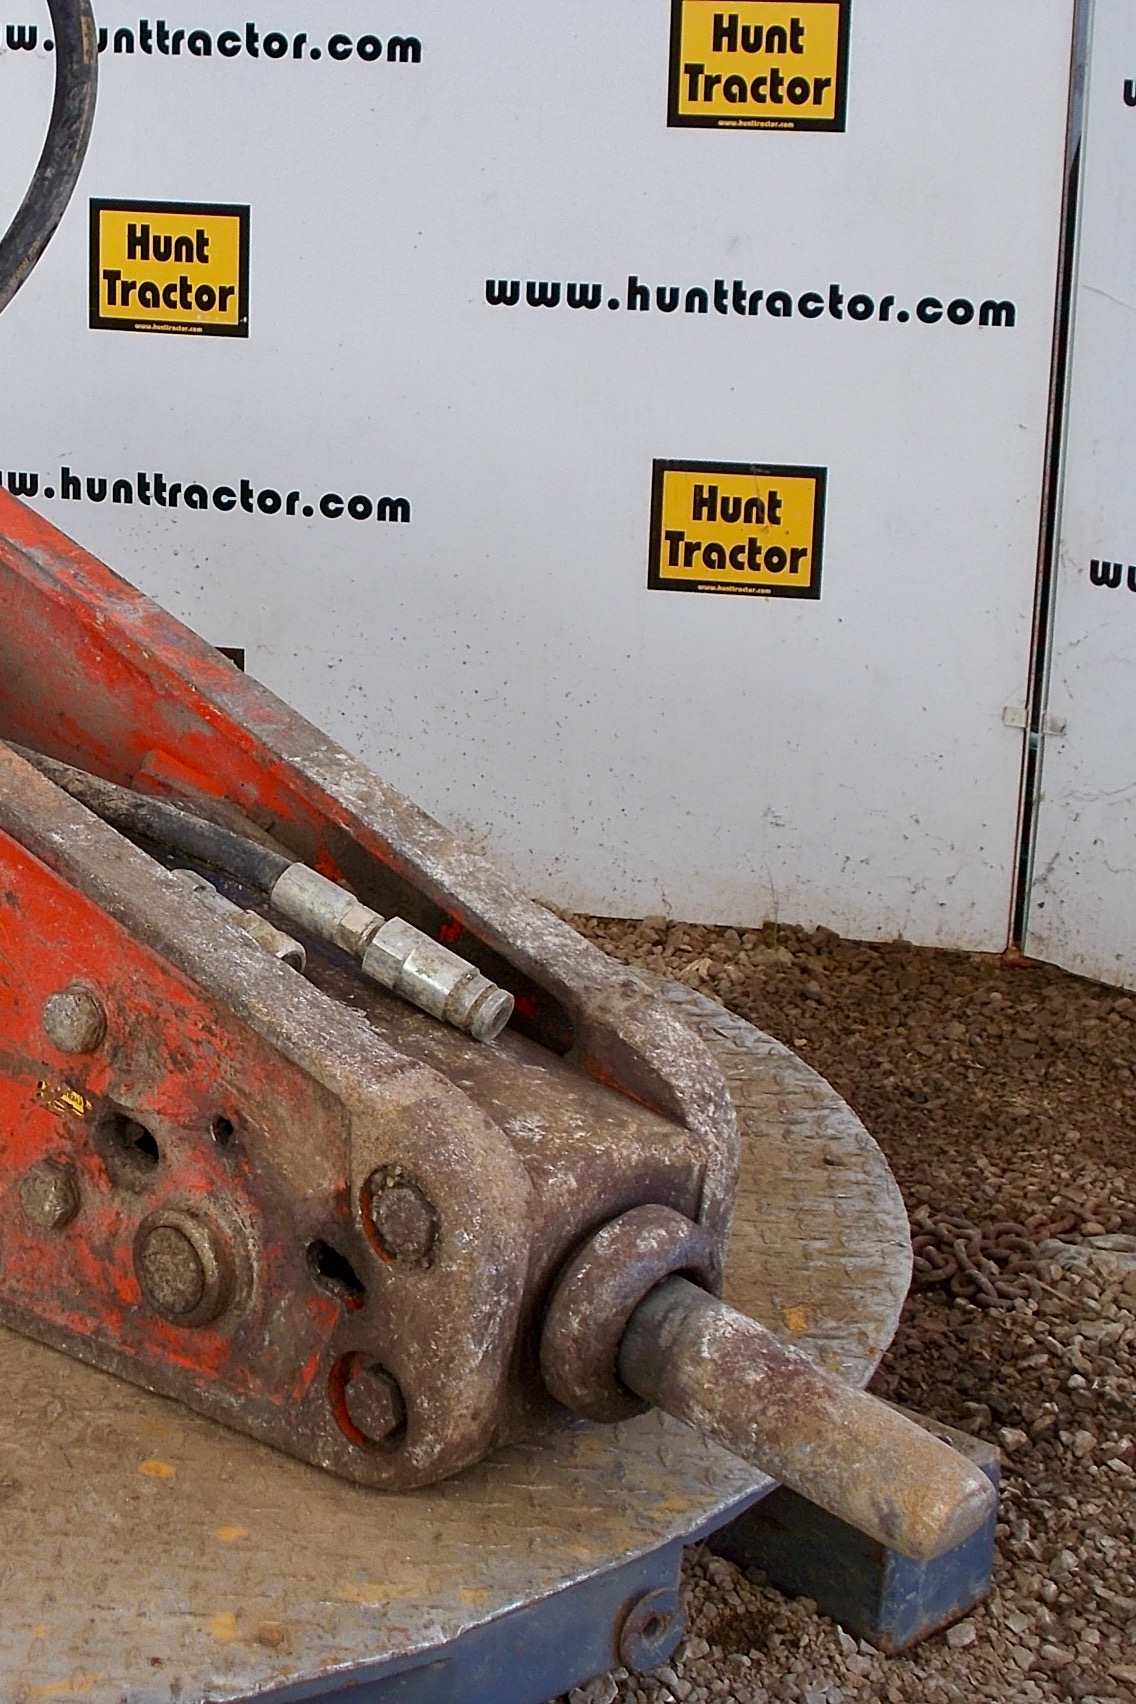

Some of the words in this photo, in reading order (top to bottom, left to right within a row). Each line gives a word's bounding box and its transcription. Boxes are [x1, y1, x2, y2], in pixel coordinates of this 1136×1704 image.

[712, 13, 805, 54] Hunt
[683, 63, 832, 105] Tractor
[127, 223, 210, 264] Hunt
[102, 269, 235, 312] Tractor
[485, 275, 1016, 327] www.hunttractor.com
[692, 484, 782, 525] Hunt
[664, 530, 808, 574] Tractor
